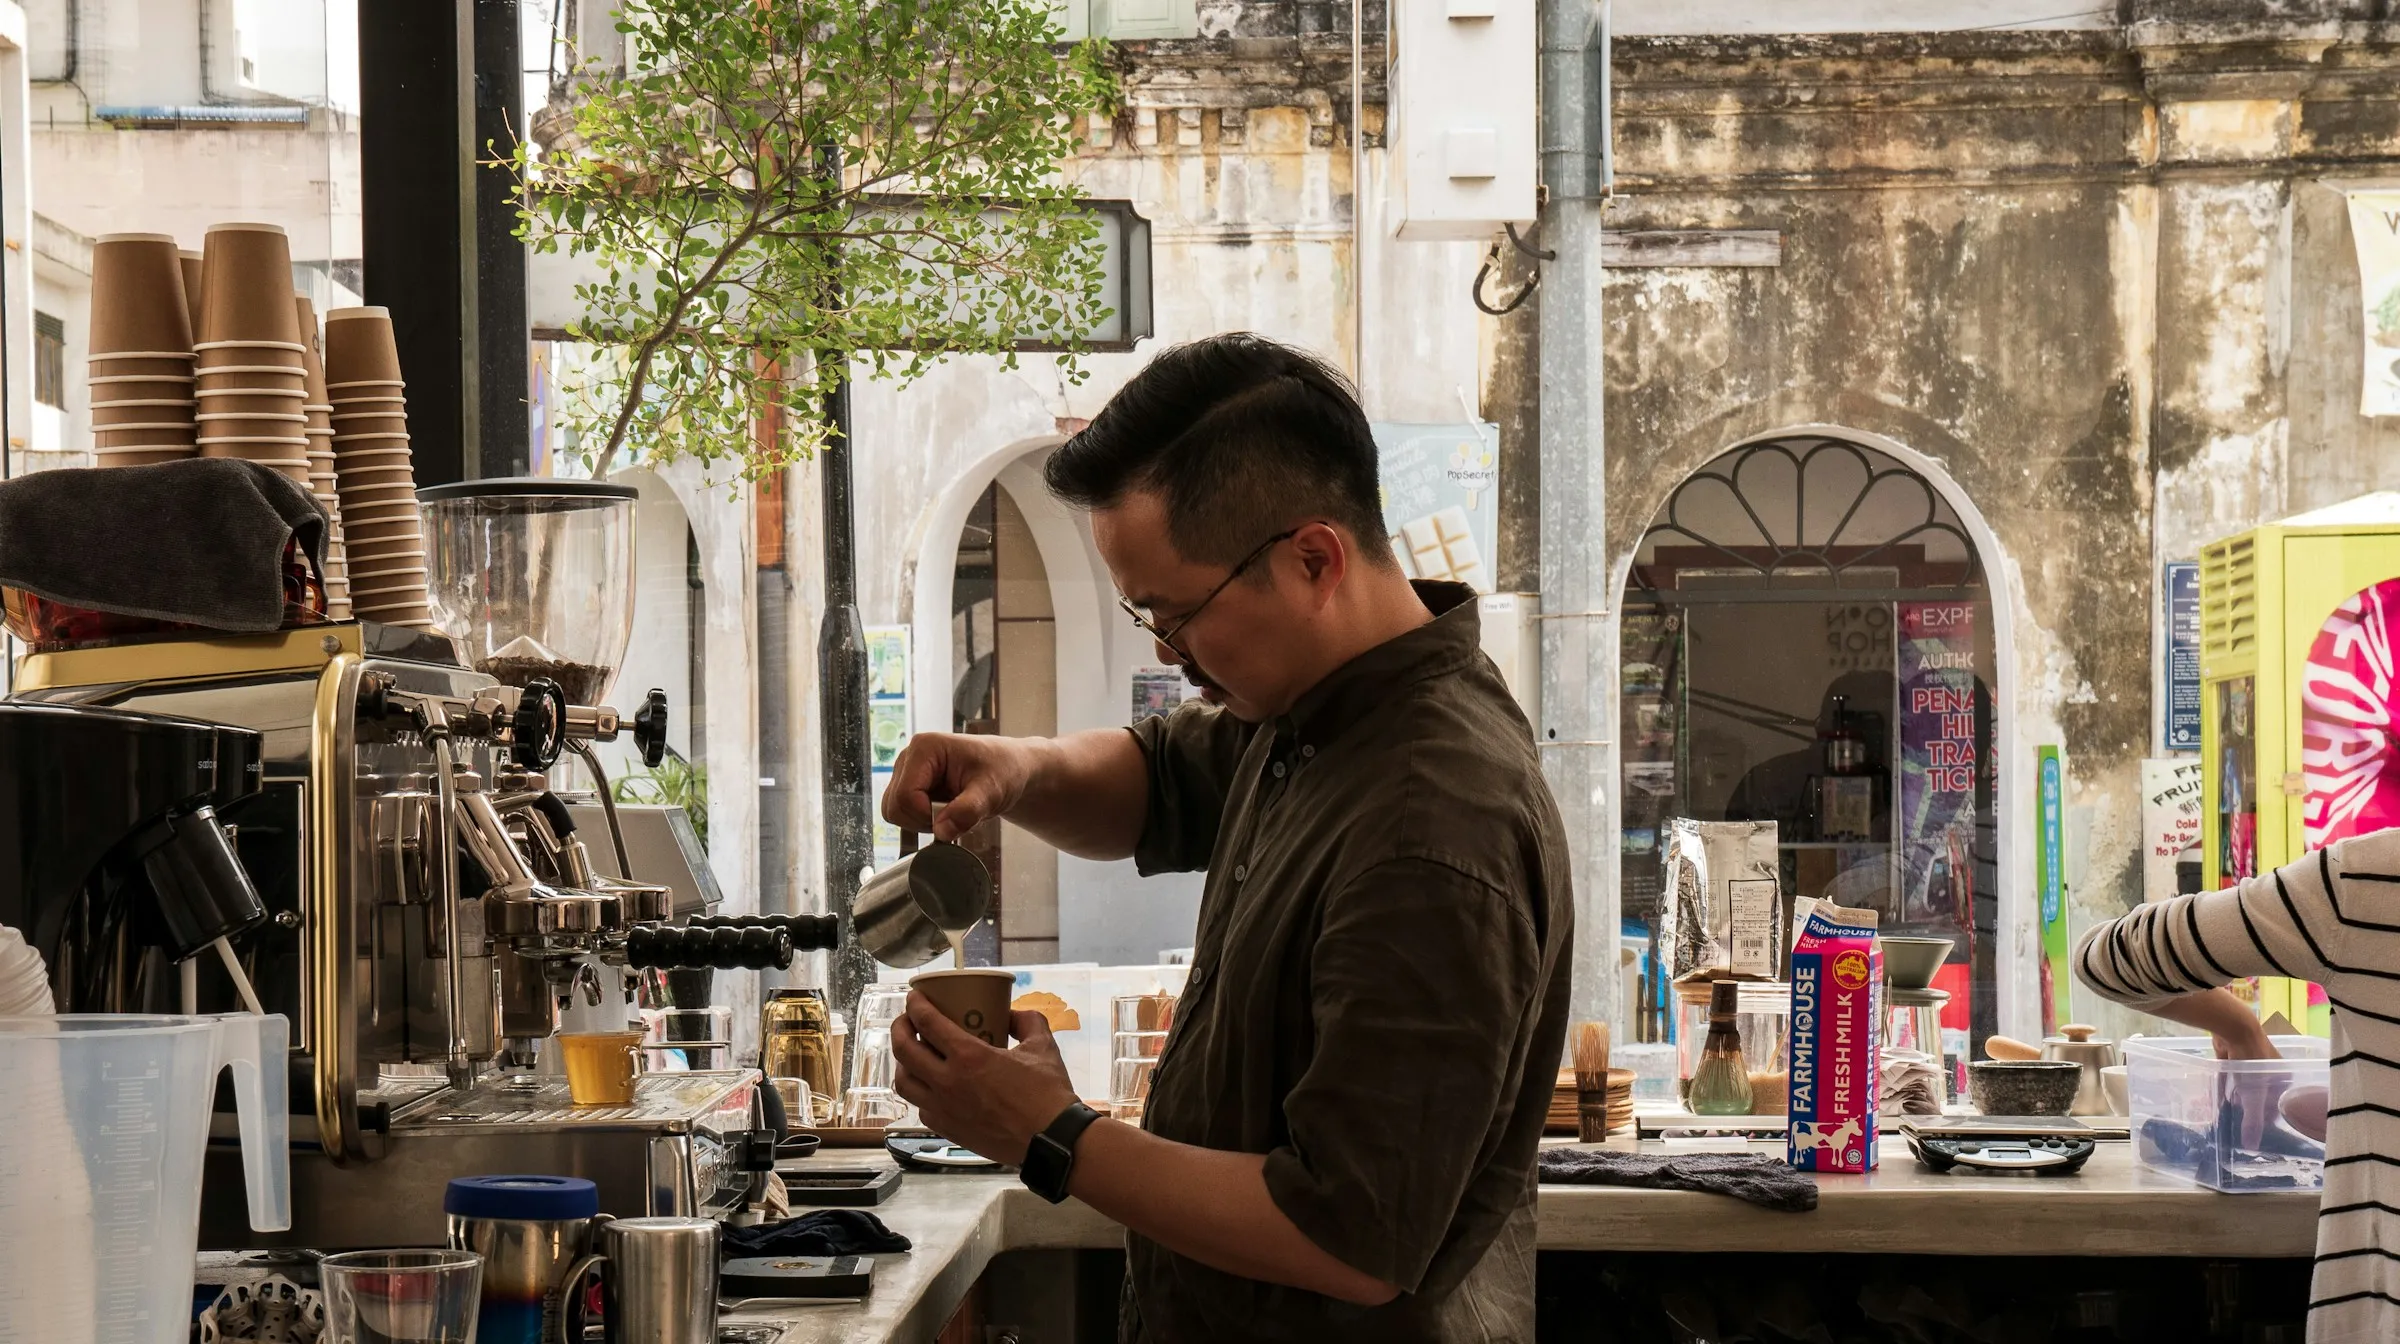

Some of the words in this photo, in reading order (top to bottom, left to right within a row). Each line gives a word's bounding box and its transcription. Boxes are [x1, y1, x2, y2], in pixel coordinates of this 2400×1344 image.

[2152, 779, 2202, 807] FRUI
[2176, 819, 2198, 828] Cold
[2163, 833, 2177, 843] No
[2155, 847, 2169, 856] No
[1809, 920, 1873, 937] FARMHOUSE
[1800, 941, 1819, 949] MILK
[1803, 935, 1827, 944] FRESH
[1837, 992, 1853, 1044] MILK
[1793, 967, 1816, 1113] FARMHOUSE
[1834, 1049, 1851, 1115] FRESH
